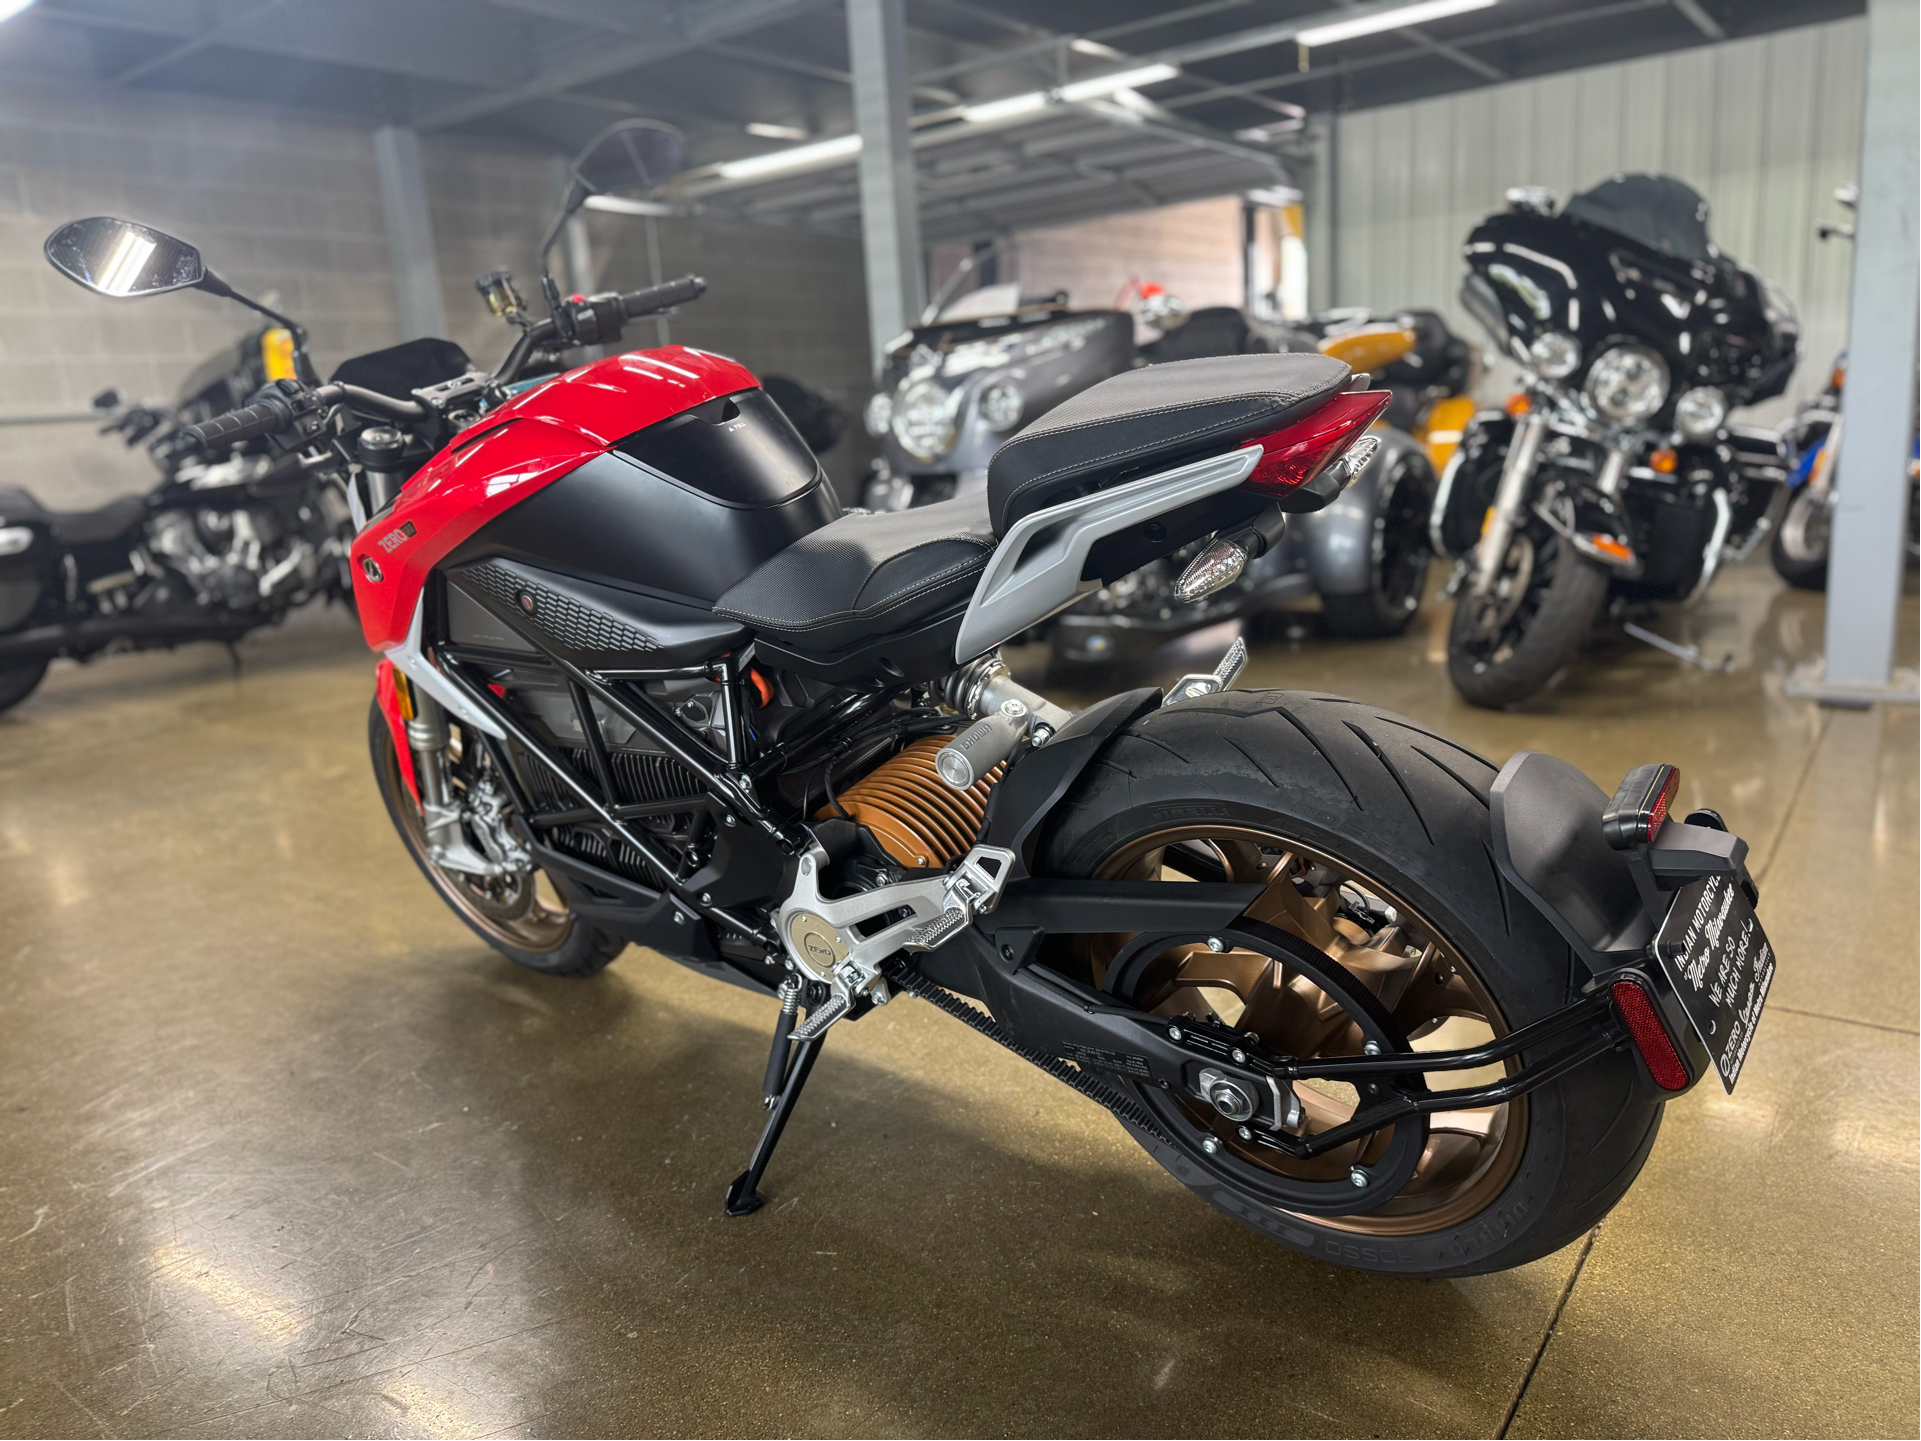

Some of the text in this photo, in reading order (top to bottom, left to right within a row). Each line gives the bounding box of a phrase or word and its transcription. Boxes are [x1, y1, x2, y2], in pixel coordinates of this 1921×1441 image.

[377, 528, 408, 554] ZERO
[808, 944, 832, 956] ZERO
[1687, 946, 1710, 992] Metro
[1704, 883, 1735, 951] Milwaukee
[1725, 920, 1752, 1008] MUCH MORE!
[1708, 936, 1736, 1008] WE ARE SO
[1725, 1021, 1741, 1060] ZERO
[1728, 1058, 1740, 1085] Indian
[1737, 1021, 1754, 1062] Motorcycle
[1753, 994, 1764, 1017] Metro
[1760, 962, 1774, 997] Milwaukee
[1325, 1239, 1414, 1264] ROSSO
